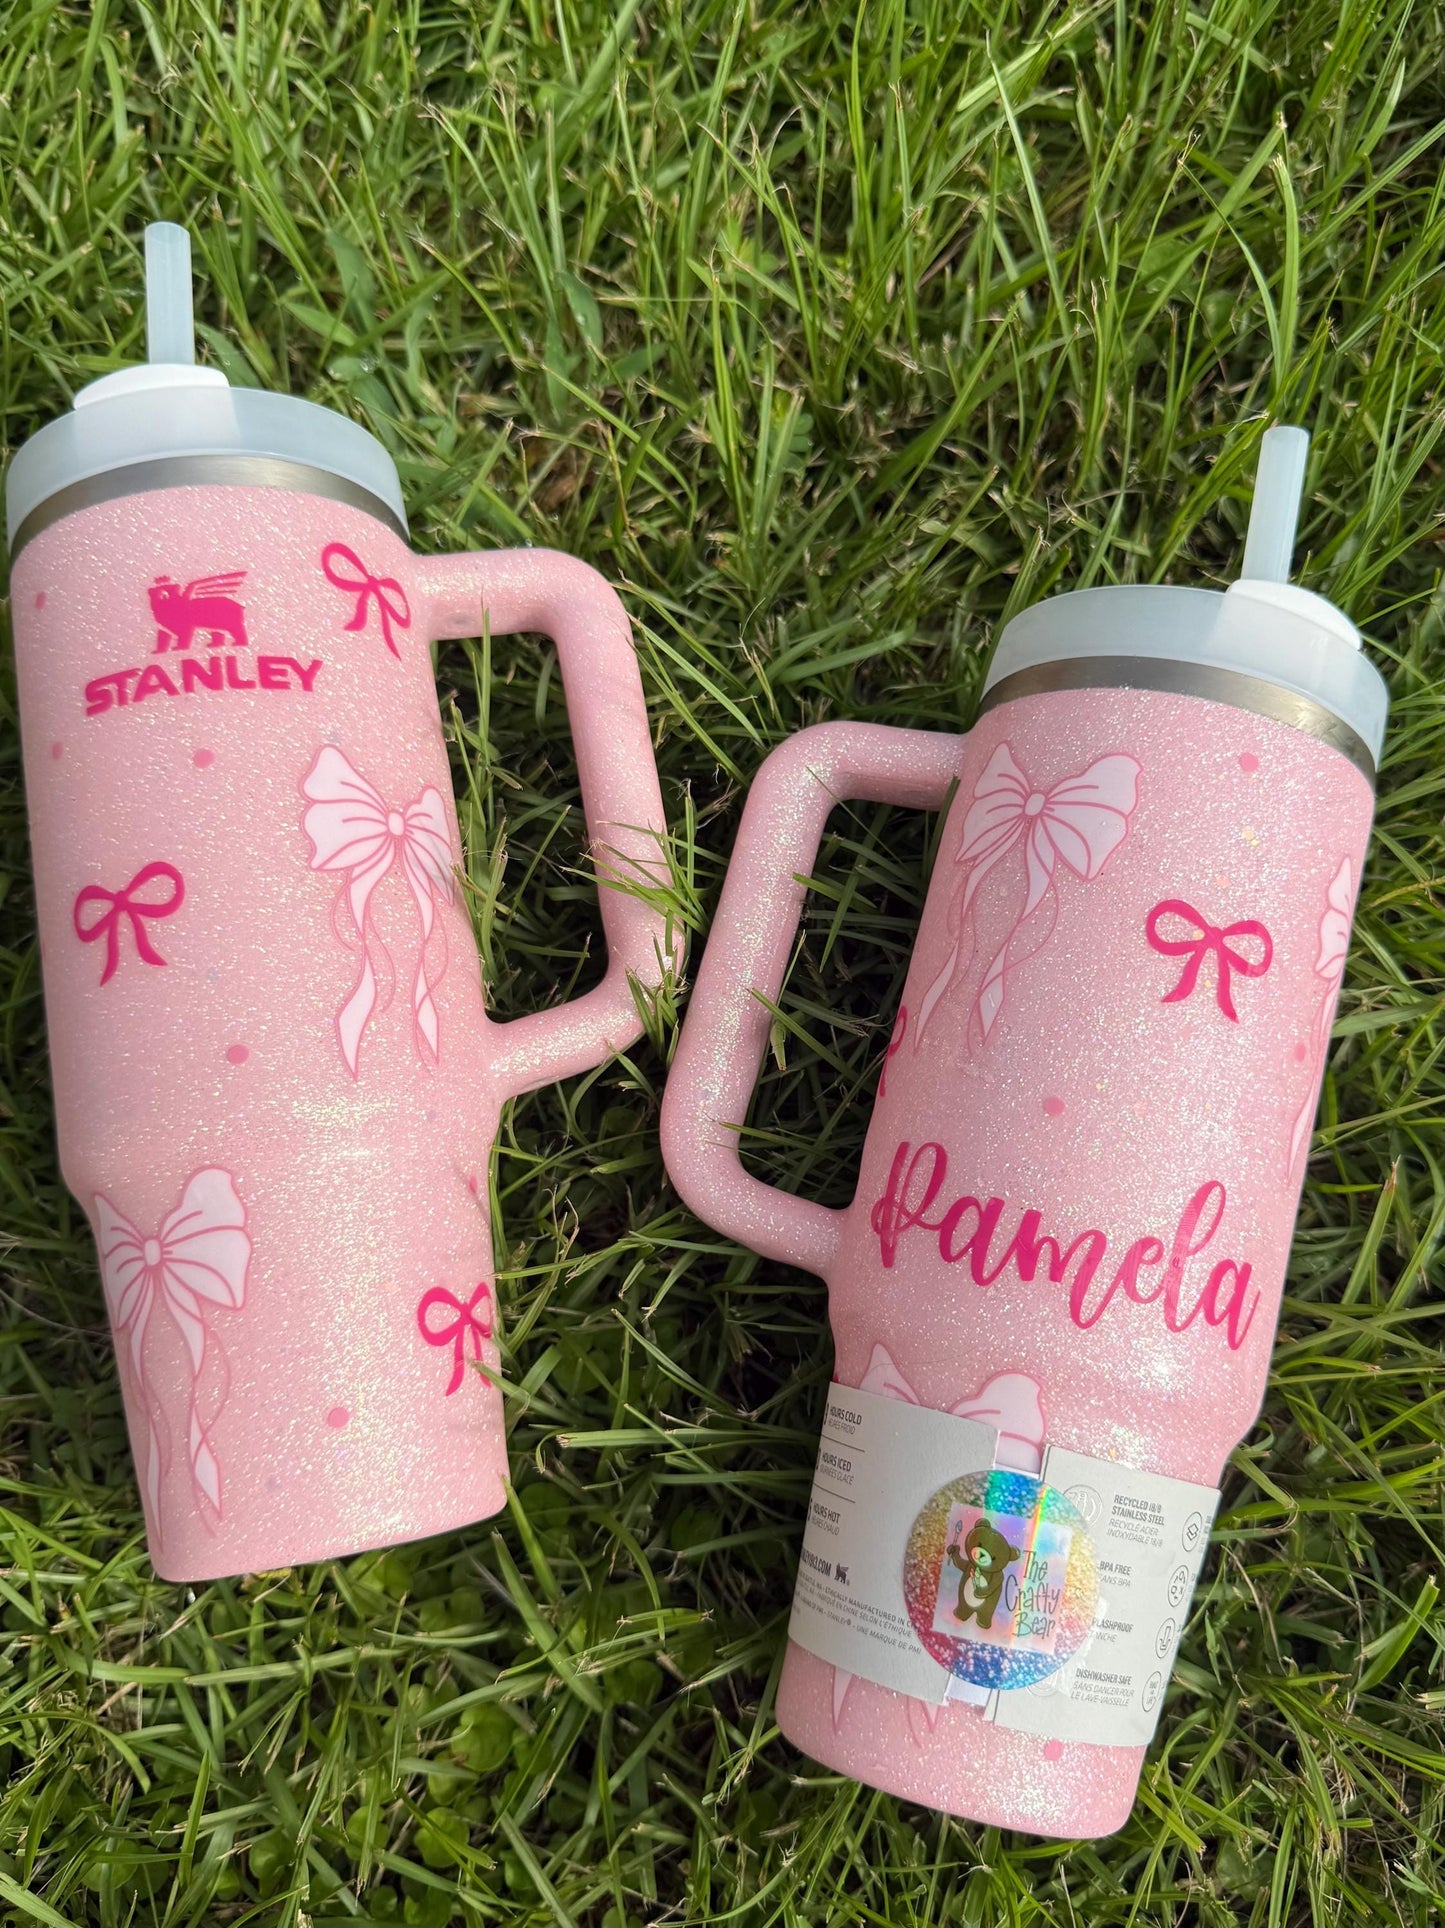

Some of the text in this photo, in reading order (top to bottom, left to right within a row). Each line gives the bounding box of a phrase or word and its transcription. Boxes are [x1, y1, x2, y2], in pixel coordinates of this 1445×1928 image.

[85, 656, 323, 717] STANLEY
[871, 1141, 1261, 1351] Pamela
[845, 1410, 862, 1425] COLD
[837, 1458, 852, 1472] ICED
[1114, 1494, 1149, 1511] RECYCLED
[828, 1509, 841, 1524] HOT
[1111, 1505, 1165, 1526] STAINLESS STEEL
[1023, 1550, 1048, 1583] The
[1100, 1560, 1132, 1576] BPA FREE
[1005, 1574, 1061, 1614] Crafty
[1012, 1612, 1056, 1639] Bear
[1076, 1667, 1132, 1686] DISHWASHER SAFE
